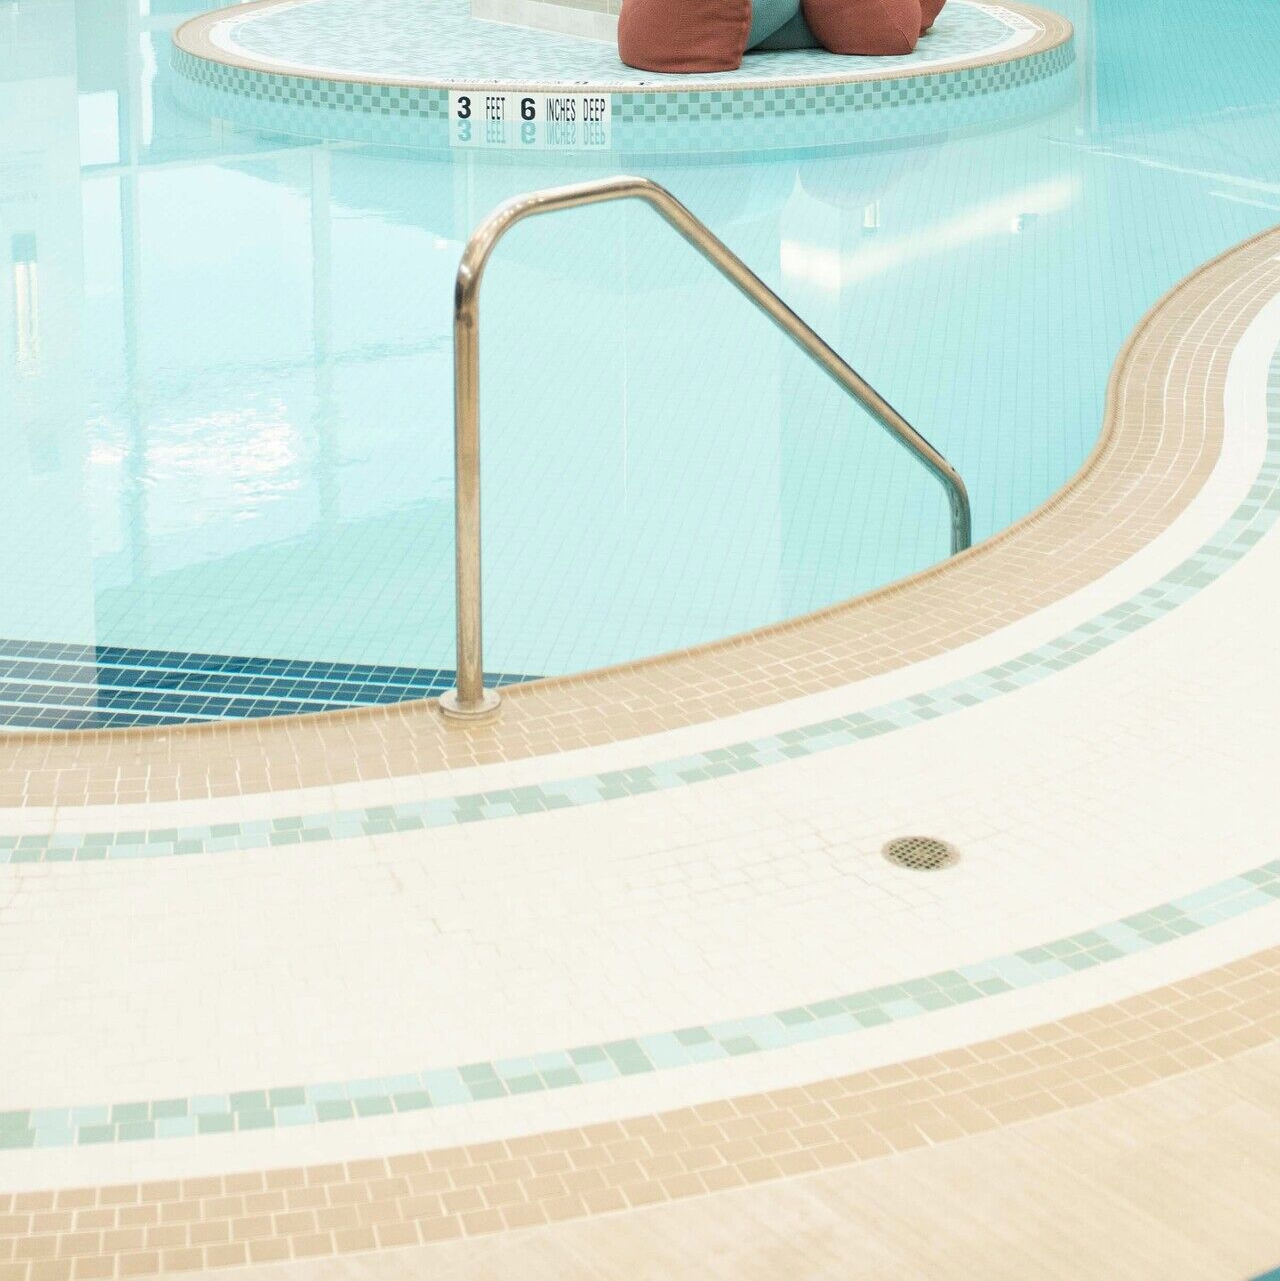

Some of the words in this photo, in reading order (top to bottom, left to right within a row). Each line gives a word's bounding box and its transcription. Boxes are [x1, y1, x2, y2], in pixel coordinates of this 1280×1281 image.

[457, 96, 471, 119] 3
[485, 96, 506, 120] FEET
[520, 97, 536, 120] 6
[546, 98, 576, 122] INCHES
[583, 98, 606, 122] DEEP
